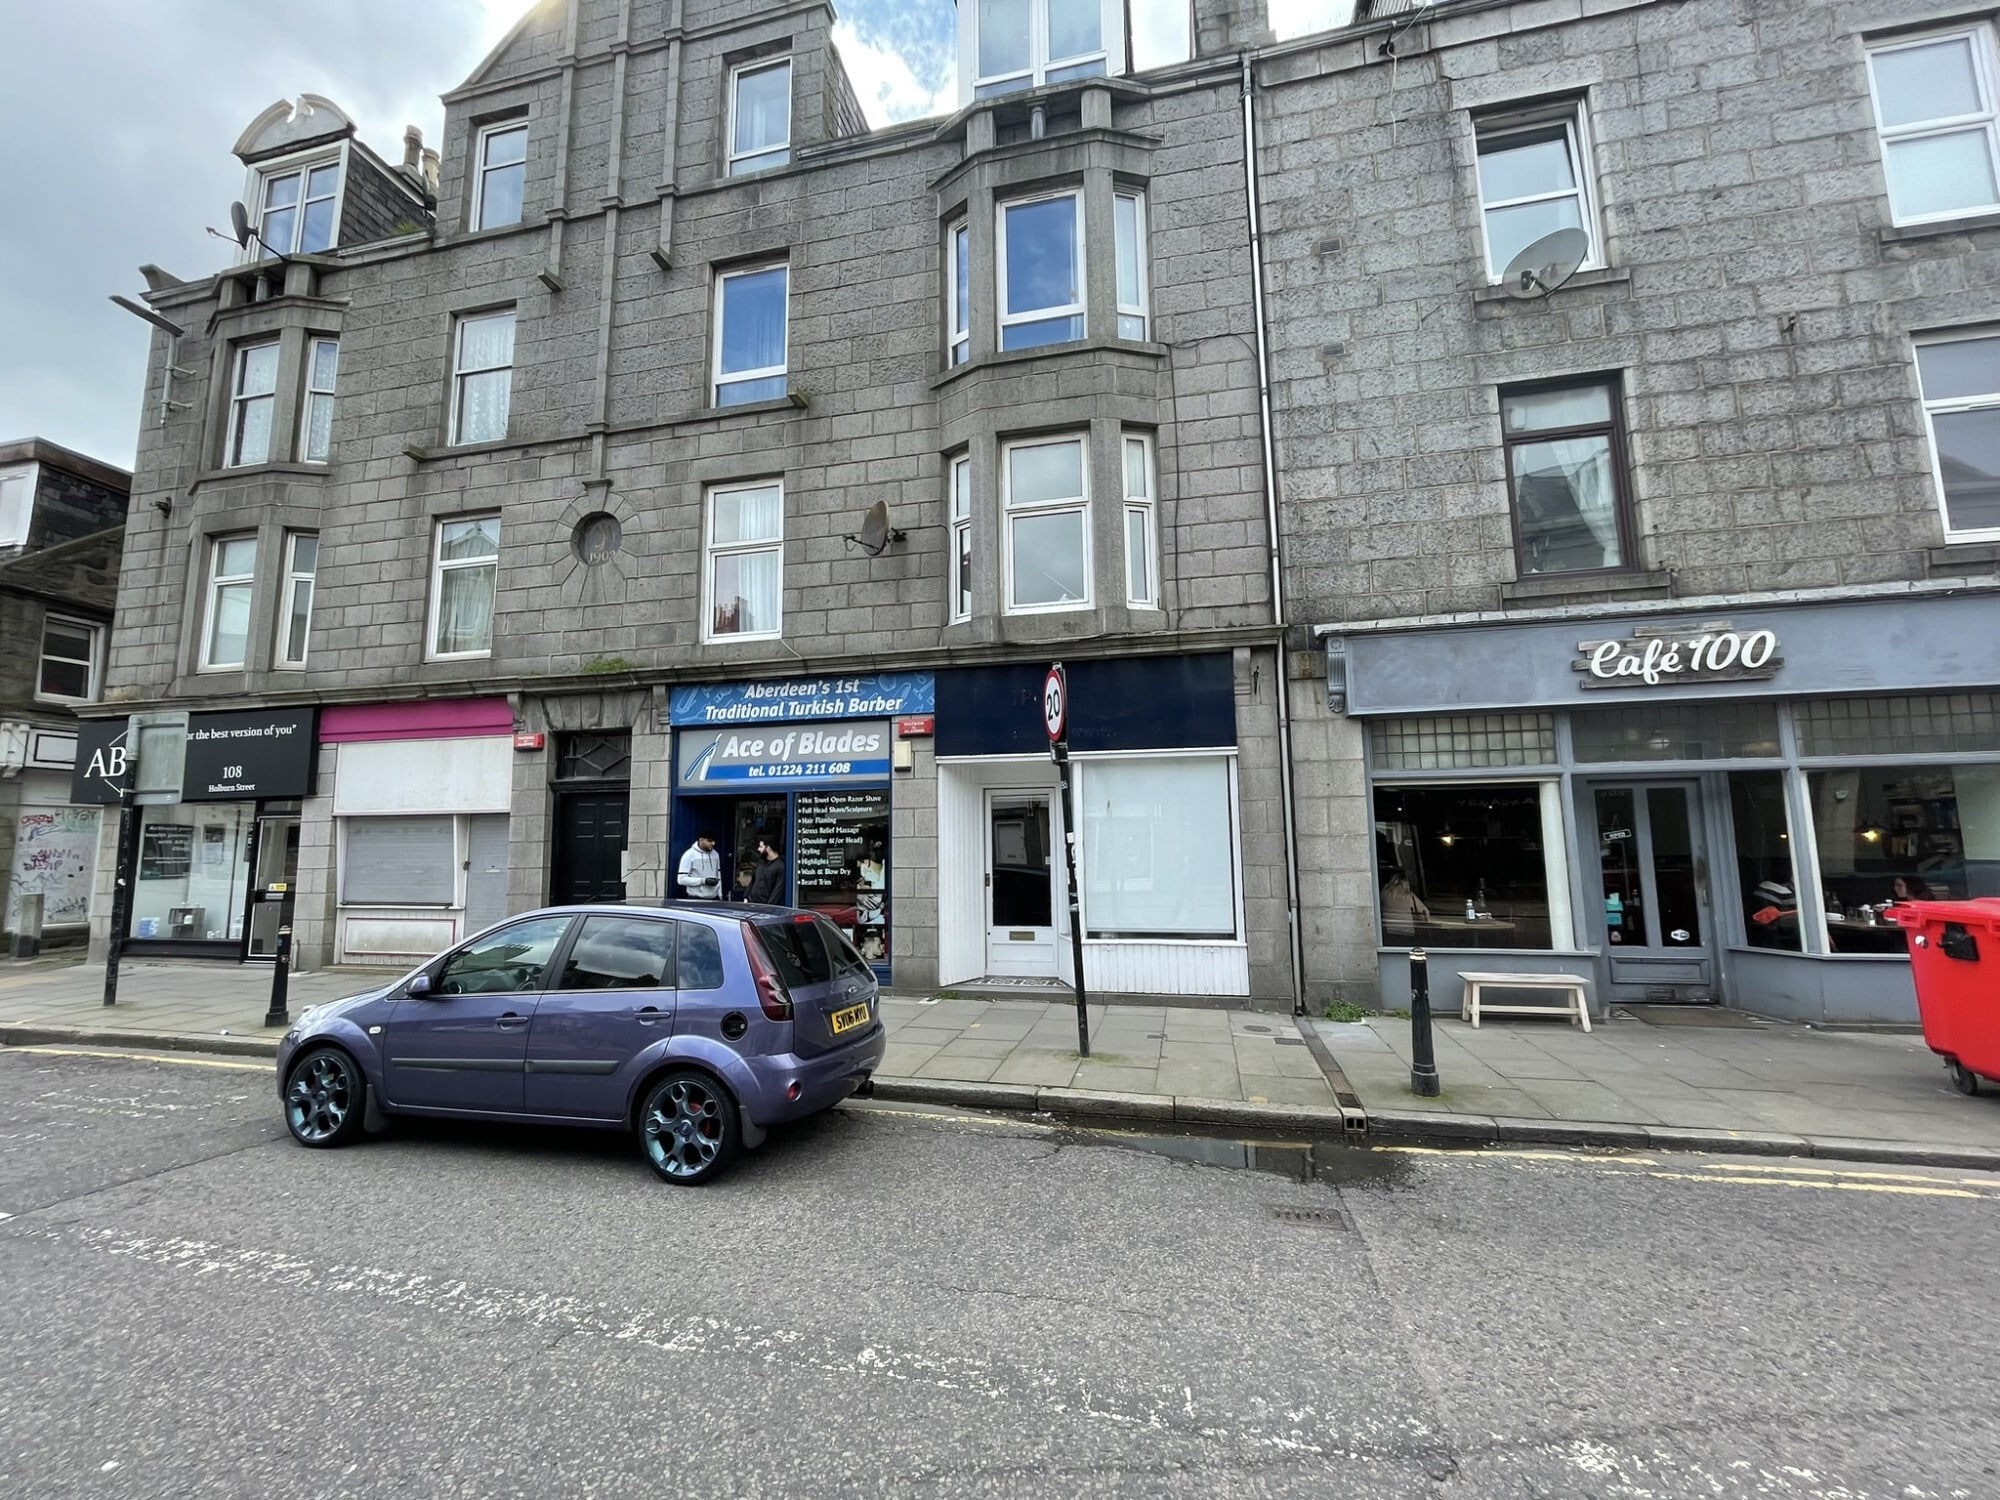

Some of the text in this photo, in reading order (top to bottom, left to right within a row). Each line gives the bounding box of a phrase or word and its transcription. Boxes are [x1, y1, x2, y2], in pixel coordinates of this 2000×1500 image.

[1591, 630, 1775, 684] Café 100
[744, 680, 859, 699] Aberdeen's 1st
[706, 696, 903, 720] Traditional Turkish Barber
[1047, 689, 1060, 721] 20
[196, 729, 209, 740] the
[211, 727, 228, 739] best
[230, 727, 262, 738] version
[264, 725, 276, 739] of
[722, 730, 880, 762] Ace of Blades
[84, 747, 126, 779] AB
[223, 766, 242, 778] 108
[749, 762, 850, 778] tel. 01224 211 608
[209, 783, 255, 793] Holburn Street
